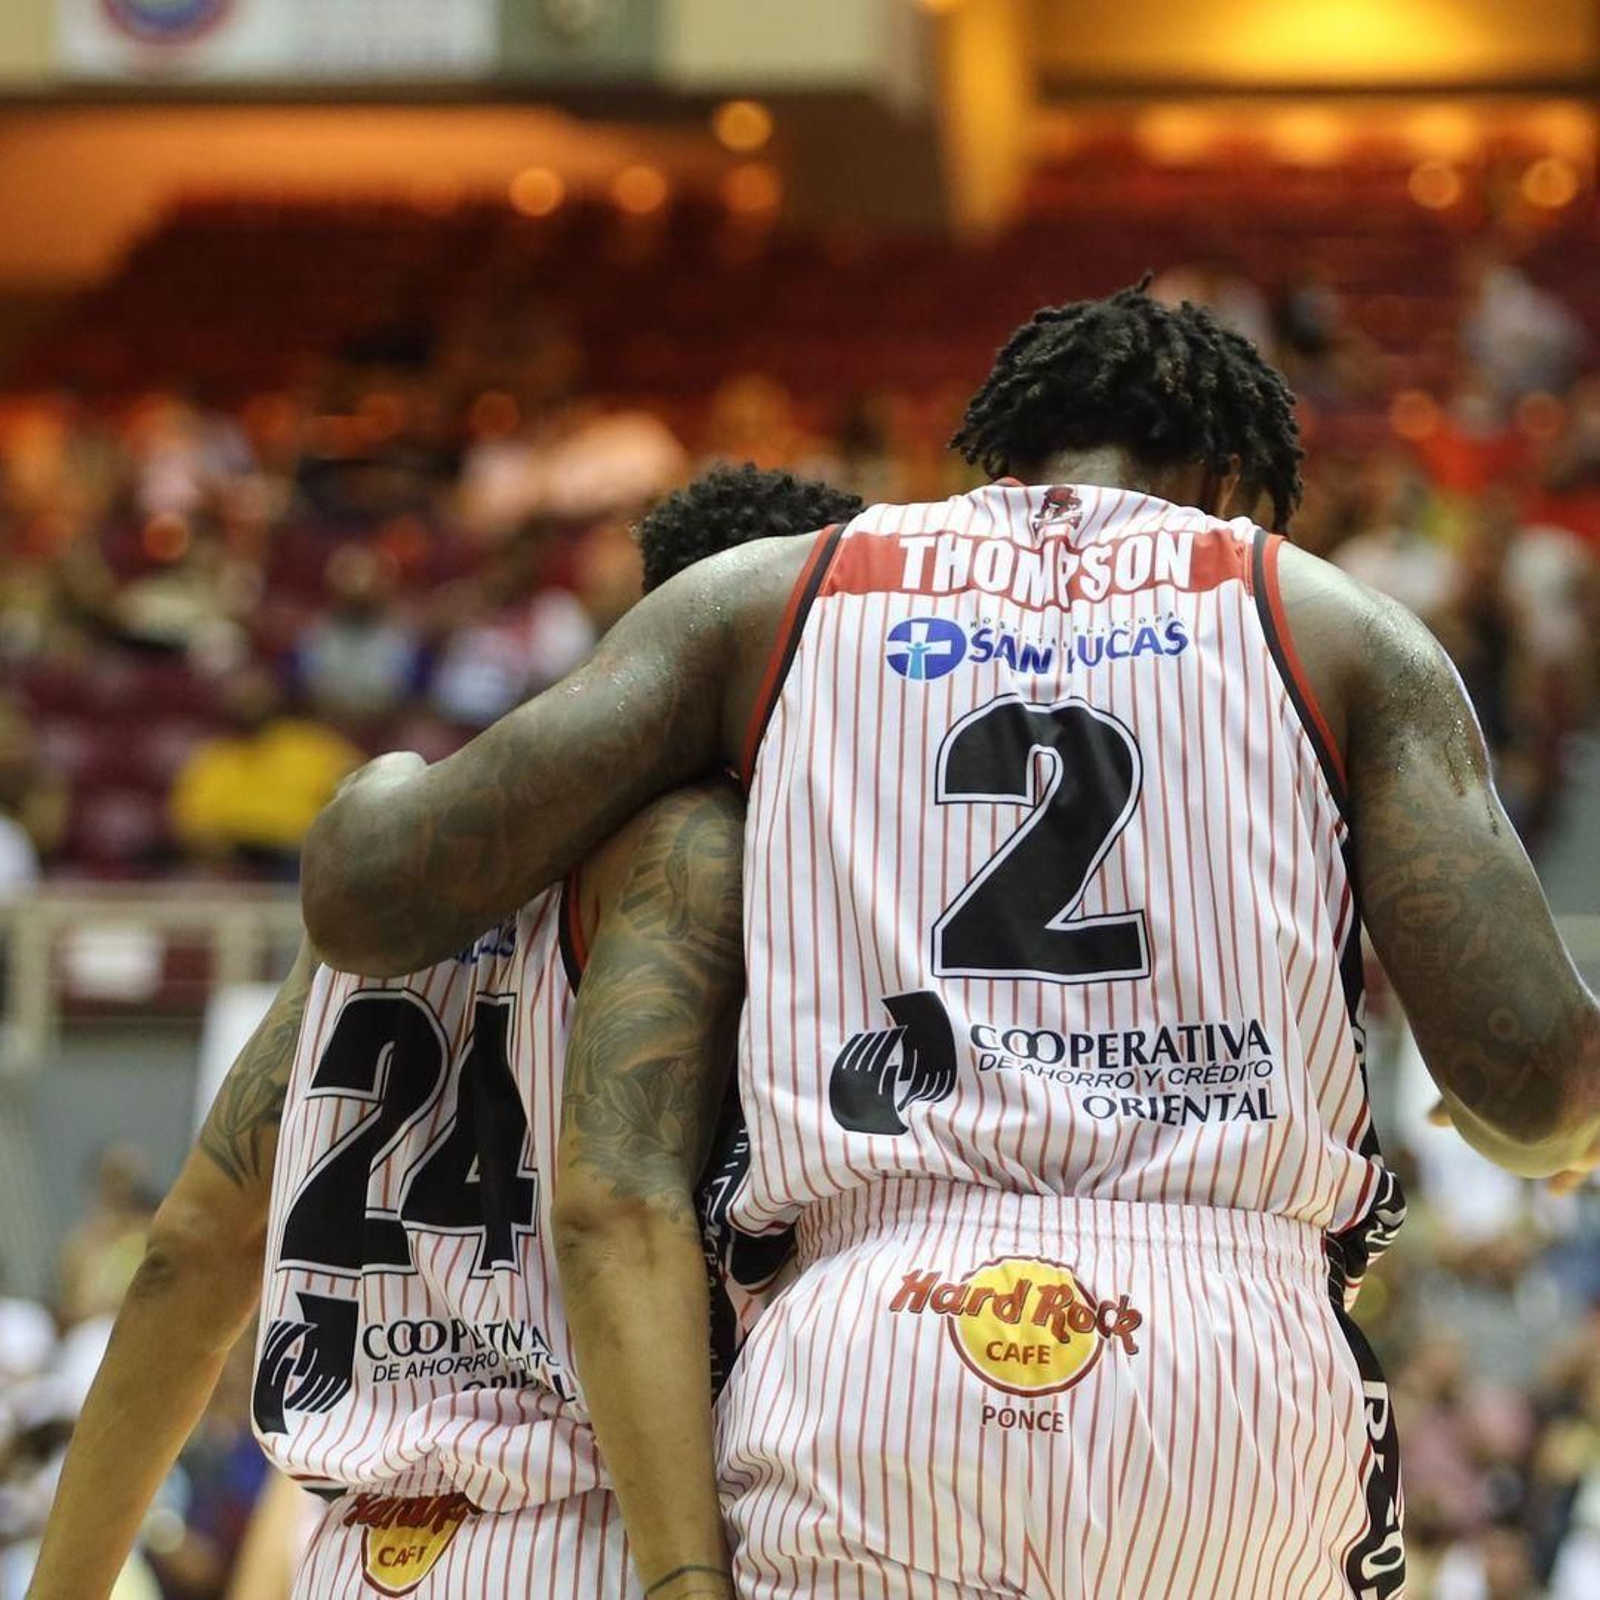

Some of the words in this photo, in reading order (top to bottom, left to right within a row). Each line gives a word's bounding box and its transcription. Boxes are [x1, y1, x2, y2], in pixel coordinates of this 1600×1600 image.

[899, 531, 1196, 608] THOMPSON
[968, 627, 1052, 675] SAN
[931, 692, 1151, 985] 2
[969, 1018, 1273, 1070] COOPERATIVA
[978, 1053, 1015, 1072] DE
[1020, 1062, 1137, 1090] AHORRO
[1142, 1068, 1162, 1087] Y
[1167, 1059, 1274, 1086] CRÉDITO
[1081, 1087, 1278, 1127] ORIENTAL
[275, 987, 541, 1280] 24
[889, 1268, 1033, 1325] Hard
[1031, 1283, 1144, 1355] Rock
[372, 1364, 400, 1383] DE
[404, 1350, 500, 1380] AHORRO
[985, 1340, 1051, 1365] CAFE
[980, 1404, 1065, 1433] PONCE
